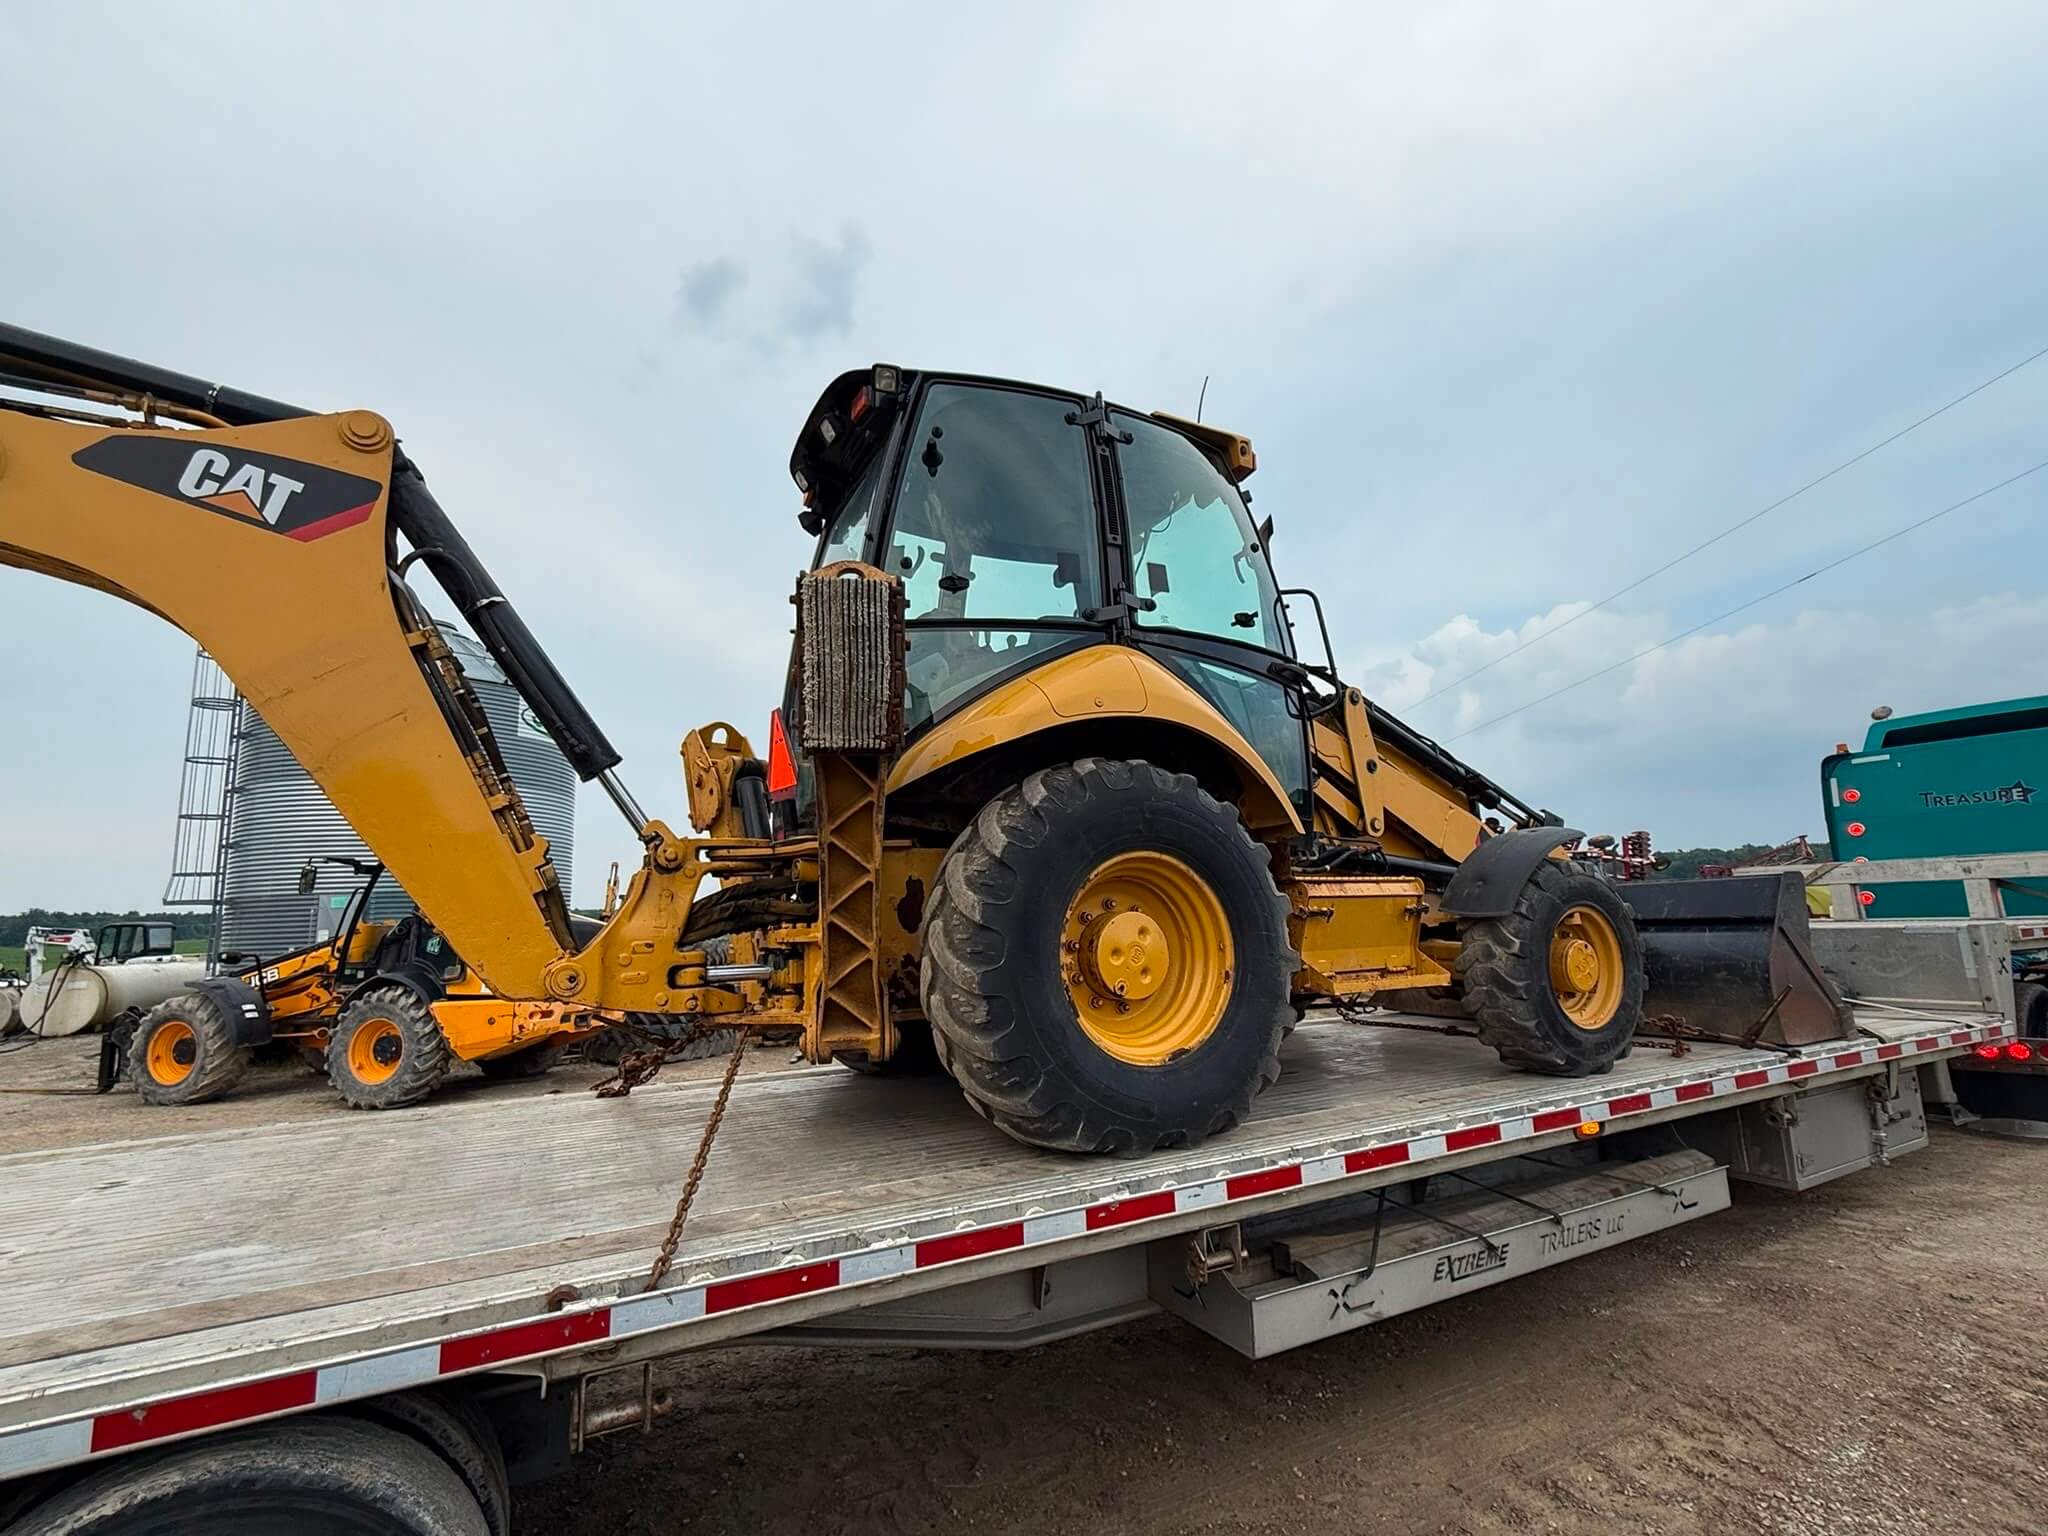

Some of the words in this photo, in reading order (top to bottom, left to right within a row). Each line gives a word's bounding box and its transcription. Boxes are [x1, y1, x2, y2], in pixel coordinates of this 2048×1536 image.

[178, 448, 305, 526] CAT
[249, 968, 280, 988] JCB
[1539, 1218, 1602, 1256] TRAILERS
[1606, 1214, 1625, 1235] LLC
